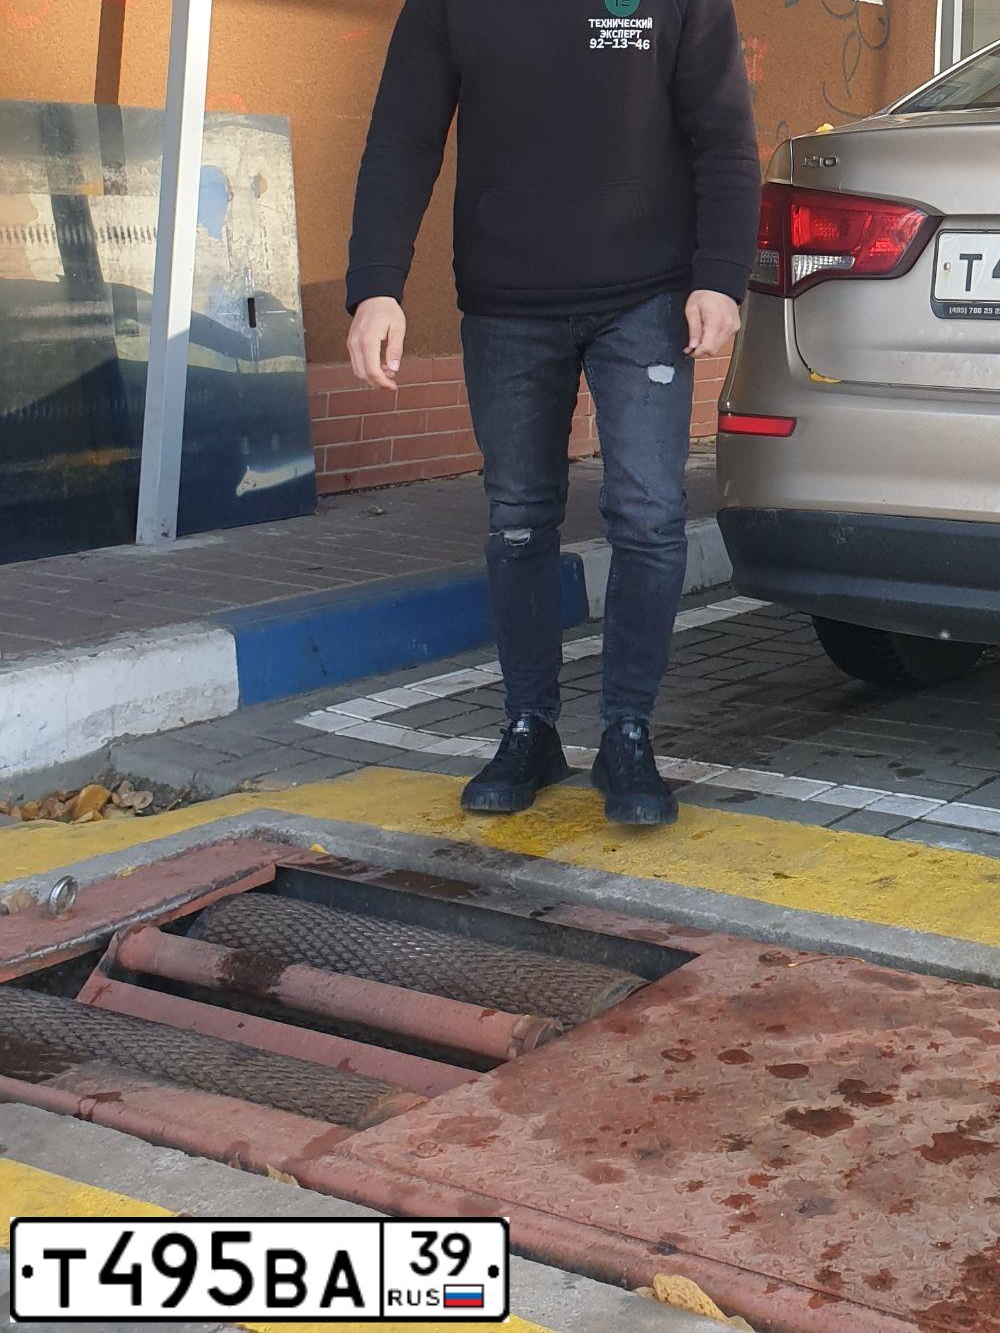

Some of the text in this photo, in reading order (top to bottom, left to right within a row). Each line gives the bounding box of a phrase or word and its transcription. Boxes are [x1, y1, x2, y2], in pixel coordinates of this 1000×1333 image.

[588, 17, 653, 29] ТЕХНИЧЕСКИЙ
[600, 29, 643, 39] ЭКСПЕРТ
[589, 38, 651, 50] 92-13-46
